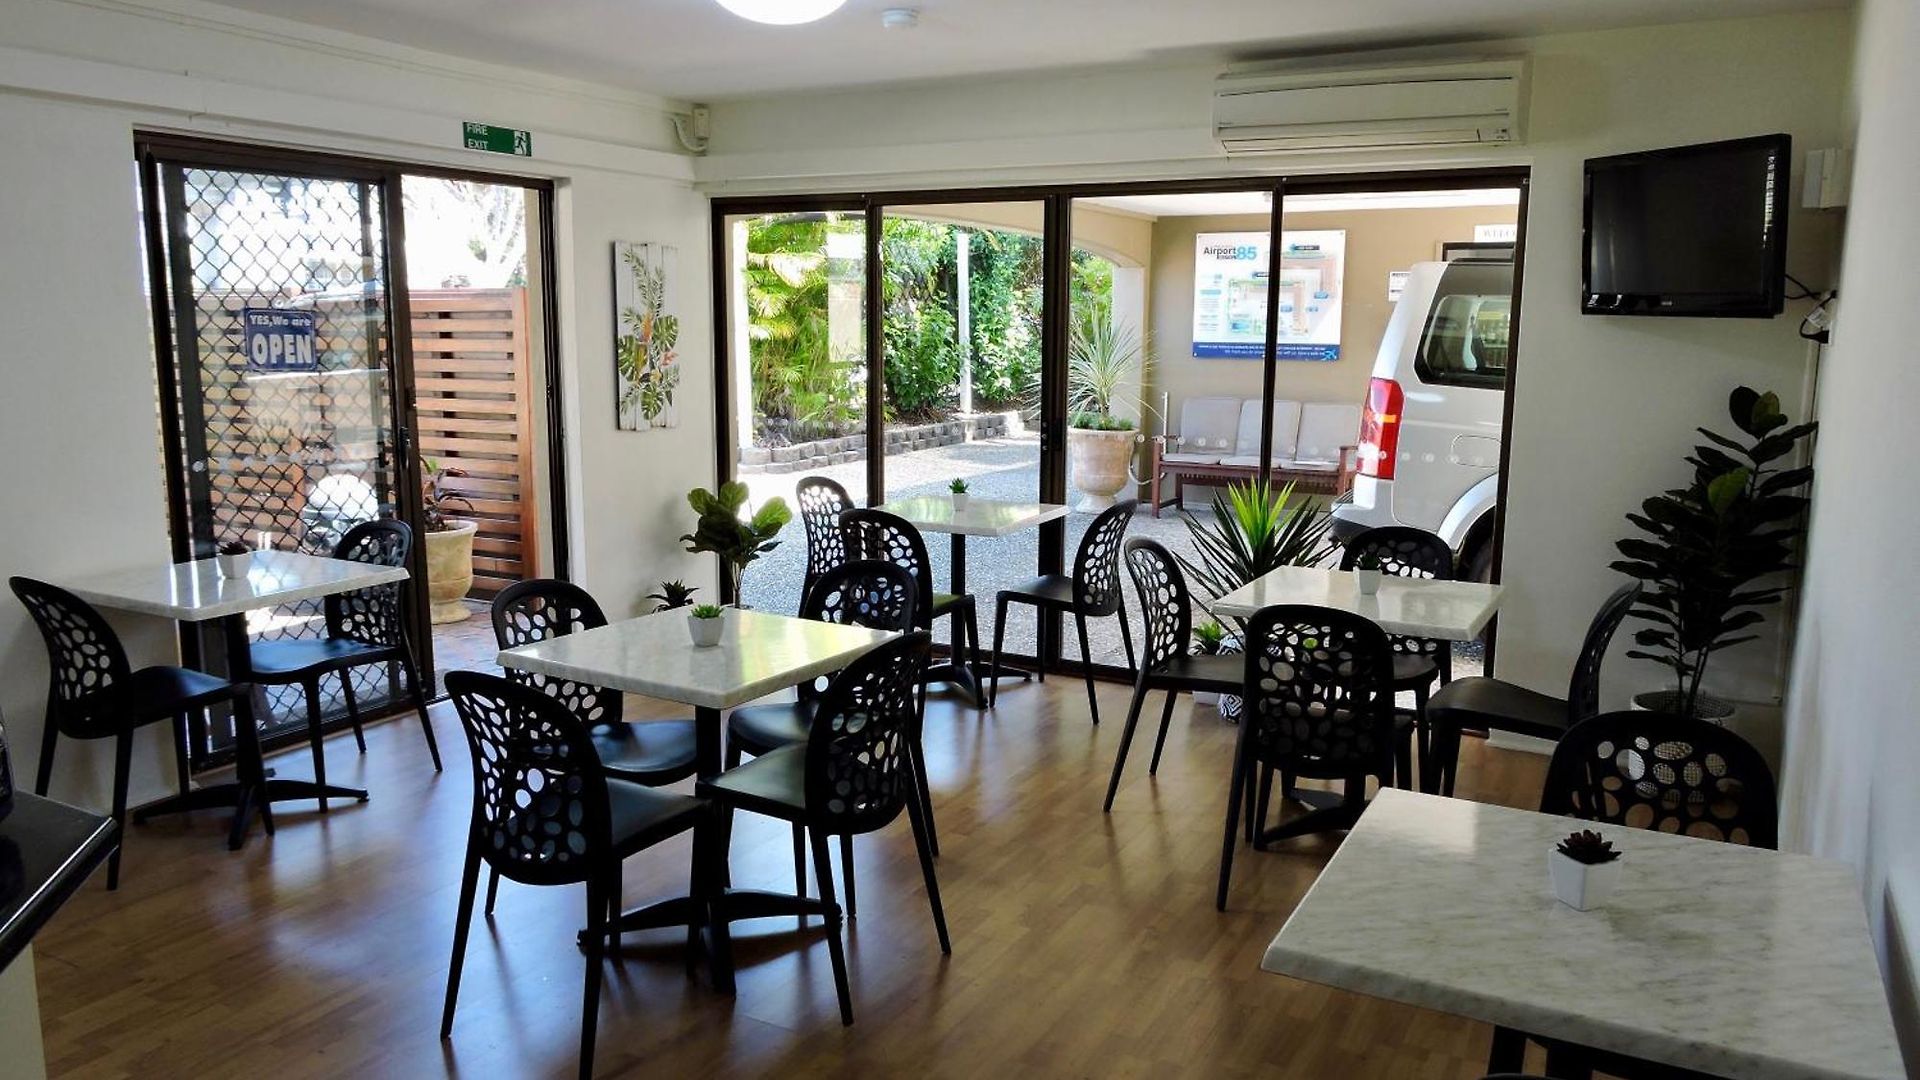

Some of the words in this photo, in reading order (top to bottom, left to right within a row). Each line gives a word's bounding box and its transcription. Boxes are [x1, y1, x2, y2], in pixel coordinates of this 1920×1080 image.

[467, 124, 488, 135] FIRE
[468, 139, 488, 150] EXIT
[252, 333, 312, 364] OPEN
